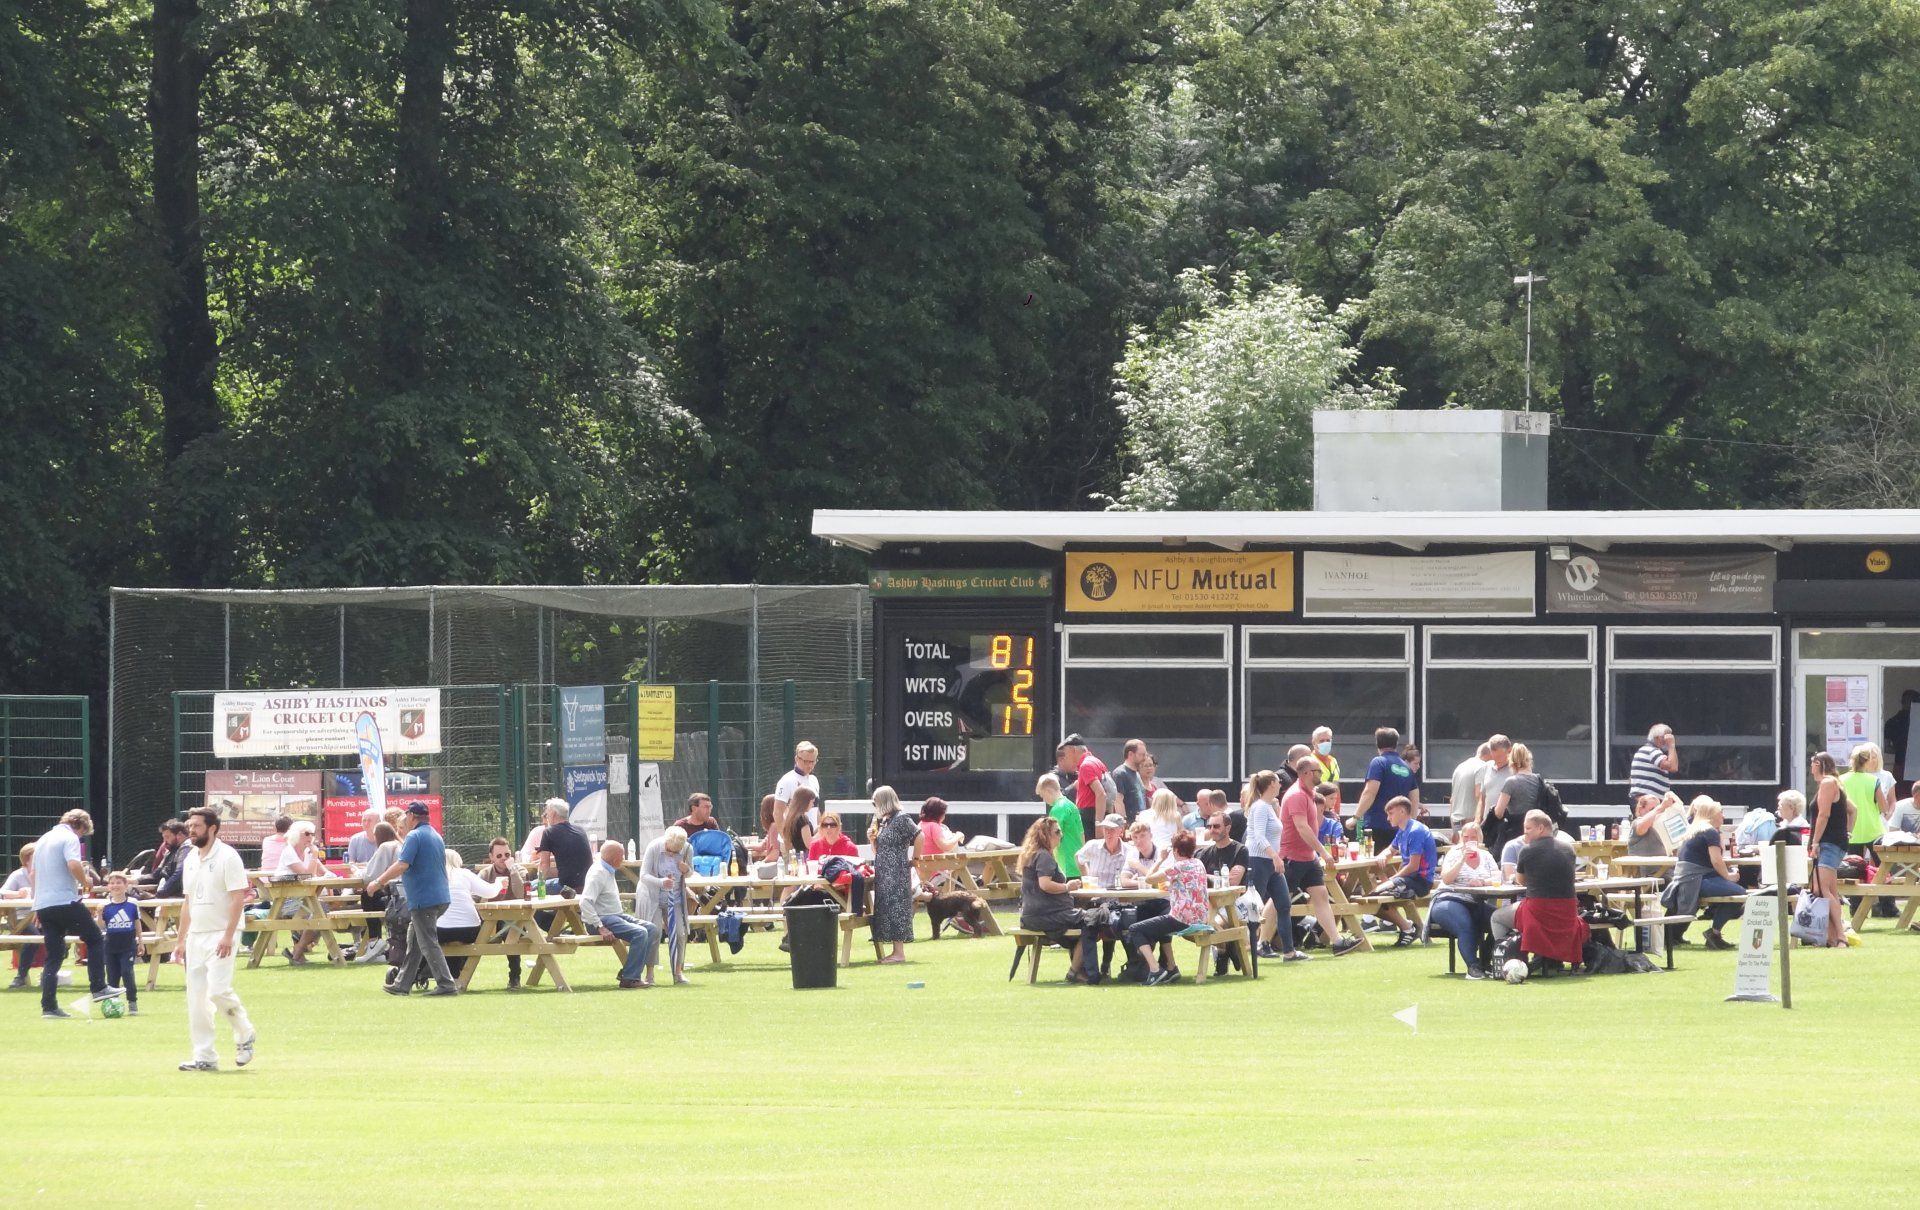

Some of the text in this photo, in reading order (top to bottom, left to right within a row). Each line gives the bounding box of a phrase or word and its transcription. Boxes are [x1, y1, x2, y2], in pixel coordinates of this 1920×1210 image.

[1133, 567, 1277, 590] NFU Mutual
[1324, 571, 1369, 580] IVANHOE
[1731, 571, 1752, 586] guide
[887, 576, 1035, 591] Ashby Hastings Cricket Club
[1710, 584, 1763, 594] with experience
[1557, 592, 1609, 601] Whitehead's
[906, 635, 1033, 668] TOTAL 81
[905, 669, 1033, 703] WKTS 2
[263, 695, 387, 709] ASHBY HASTINGS
[273, 711, 336, 724] CRICKET
[904, 703, 1033, 734] OVERS 17
[904, 744, 966, 761] 1ST INNS
[252, 772, 295, 783] Lion Court
[392, 775, 427, 791] HILL
[573, 770, 596, 785] Sedgwick
[1755, 900, 1769, 908] Ashby
